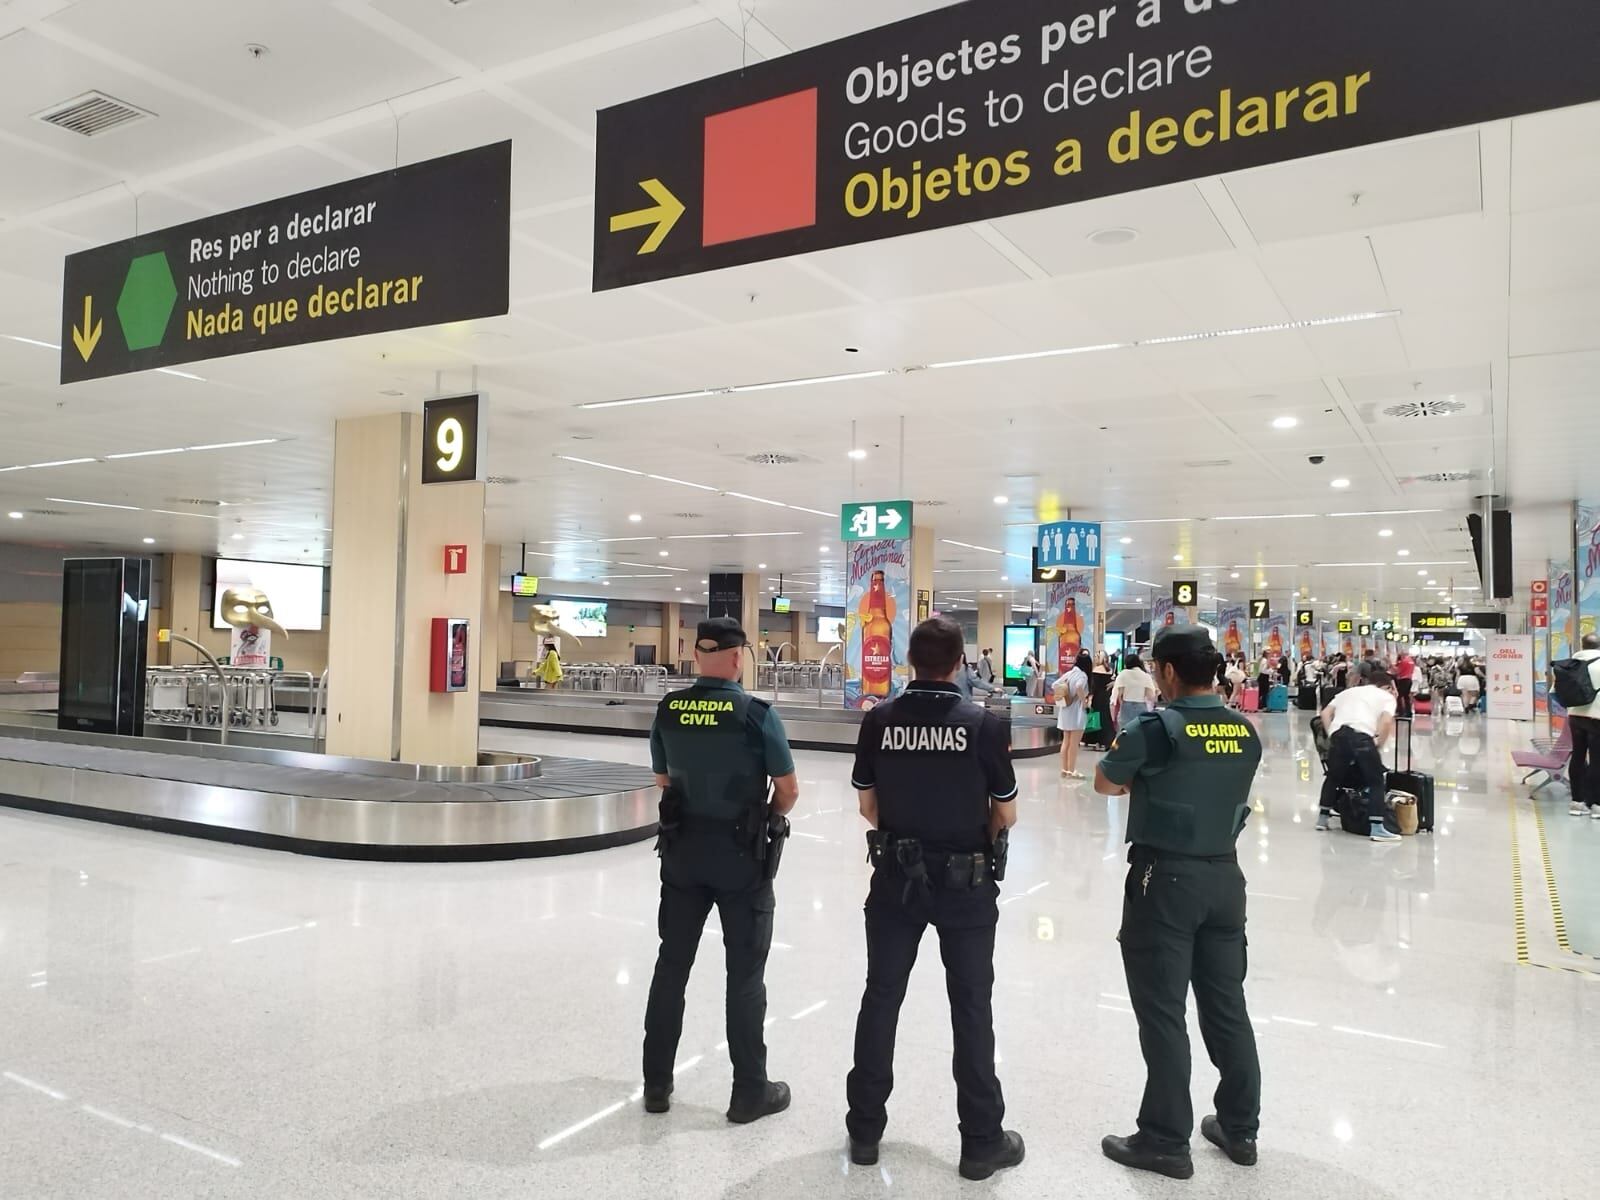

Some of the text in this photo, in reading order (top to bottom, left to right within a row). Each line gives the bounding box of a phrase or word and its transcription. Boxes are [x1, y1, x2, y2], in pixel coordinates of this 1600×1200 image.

[845, 0, 1161, 105] Objectes per a
[844, 45, 1213, 160] Goods to declare
[844, 71, 1371, 218] Objetos a declarar
[189, 201, 377, 263] Res per a declarar
[187, 245, 361, 300] Nothing to declare
[186, 275, 423, 340] Nada que declarar
[435, 417, 464, 472] 9
[1177, 584, 1192, 603] 8
[1253, 601, 1266, 617] 7
[1300, 612, 1310, 624] 6
[669, 699, 734, 712] GUARDIA
[680, 713, 719, 726] CIVIL
[880, 725, 967, 753] ADUANAS
[1185, 722, 1250, 738] GUARDIA
[1205, 740, 1243, 754] CIVIL
